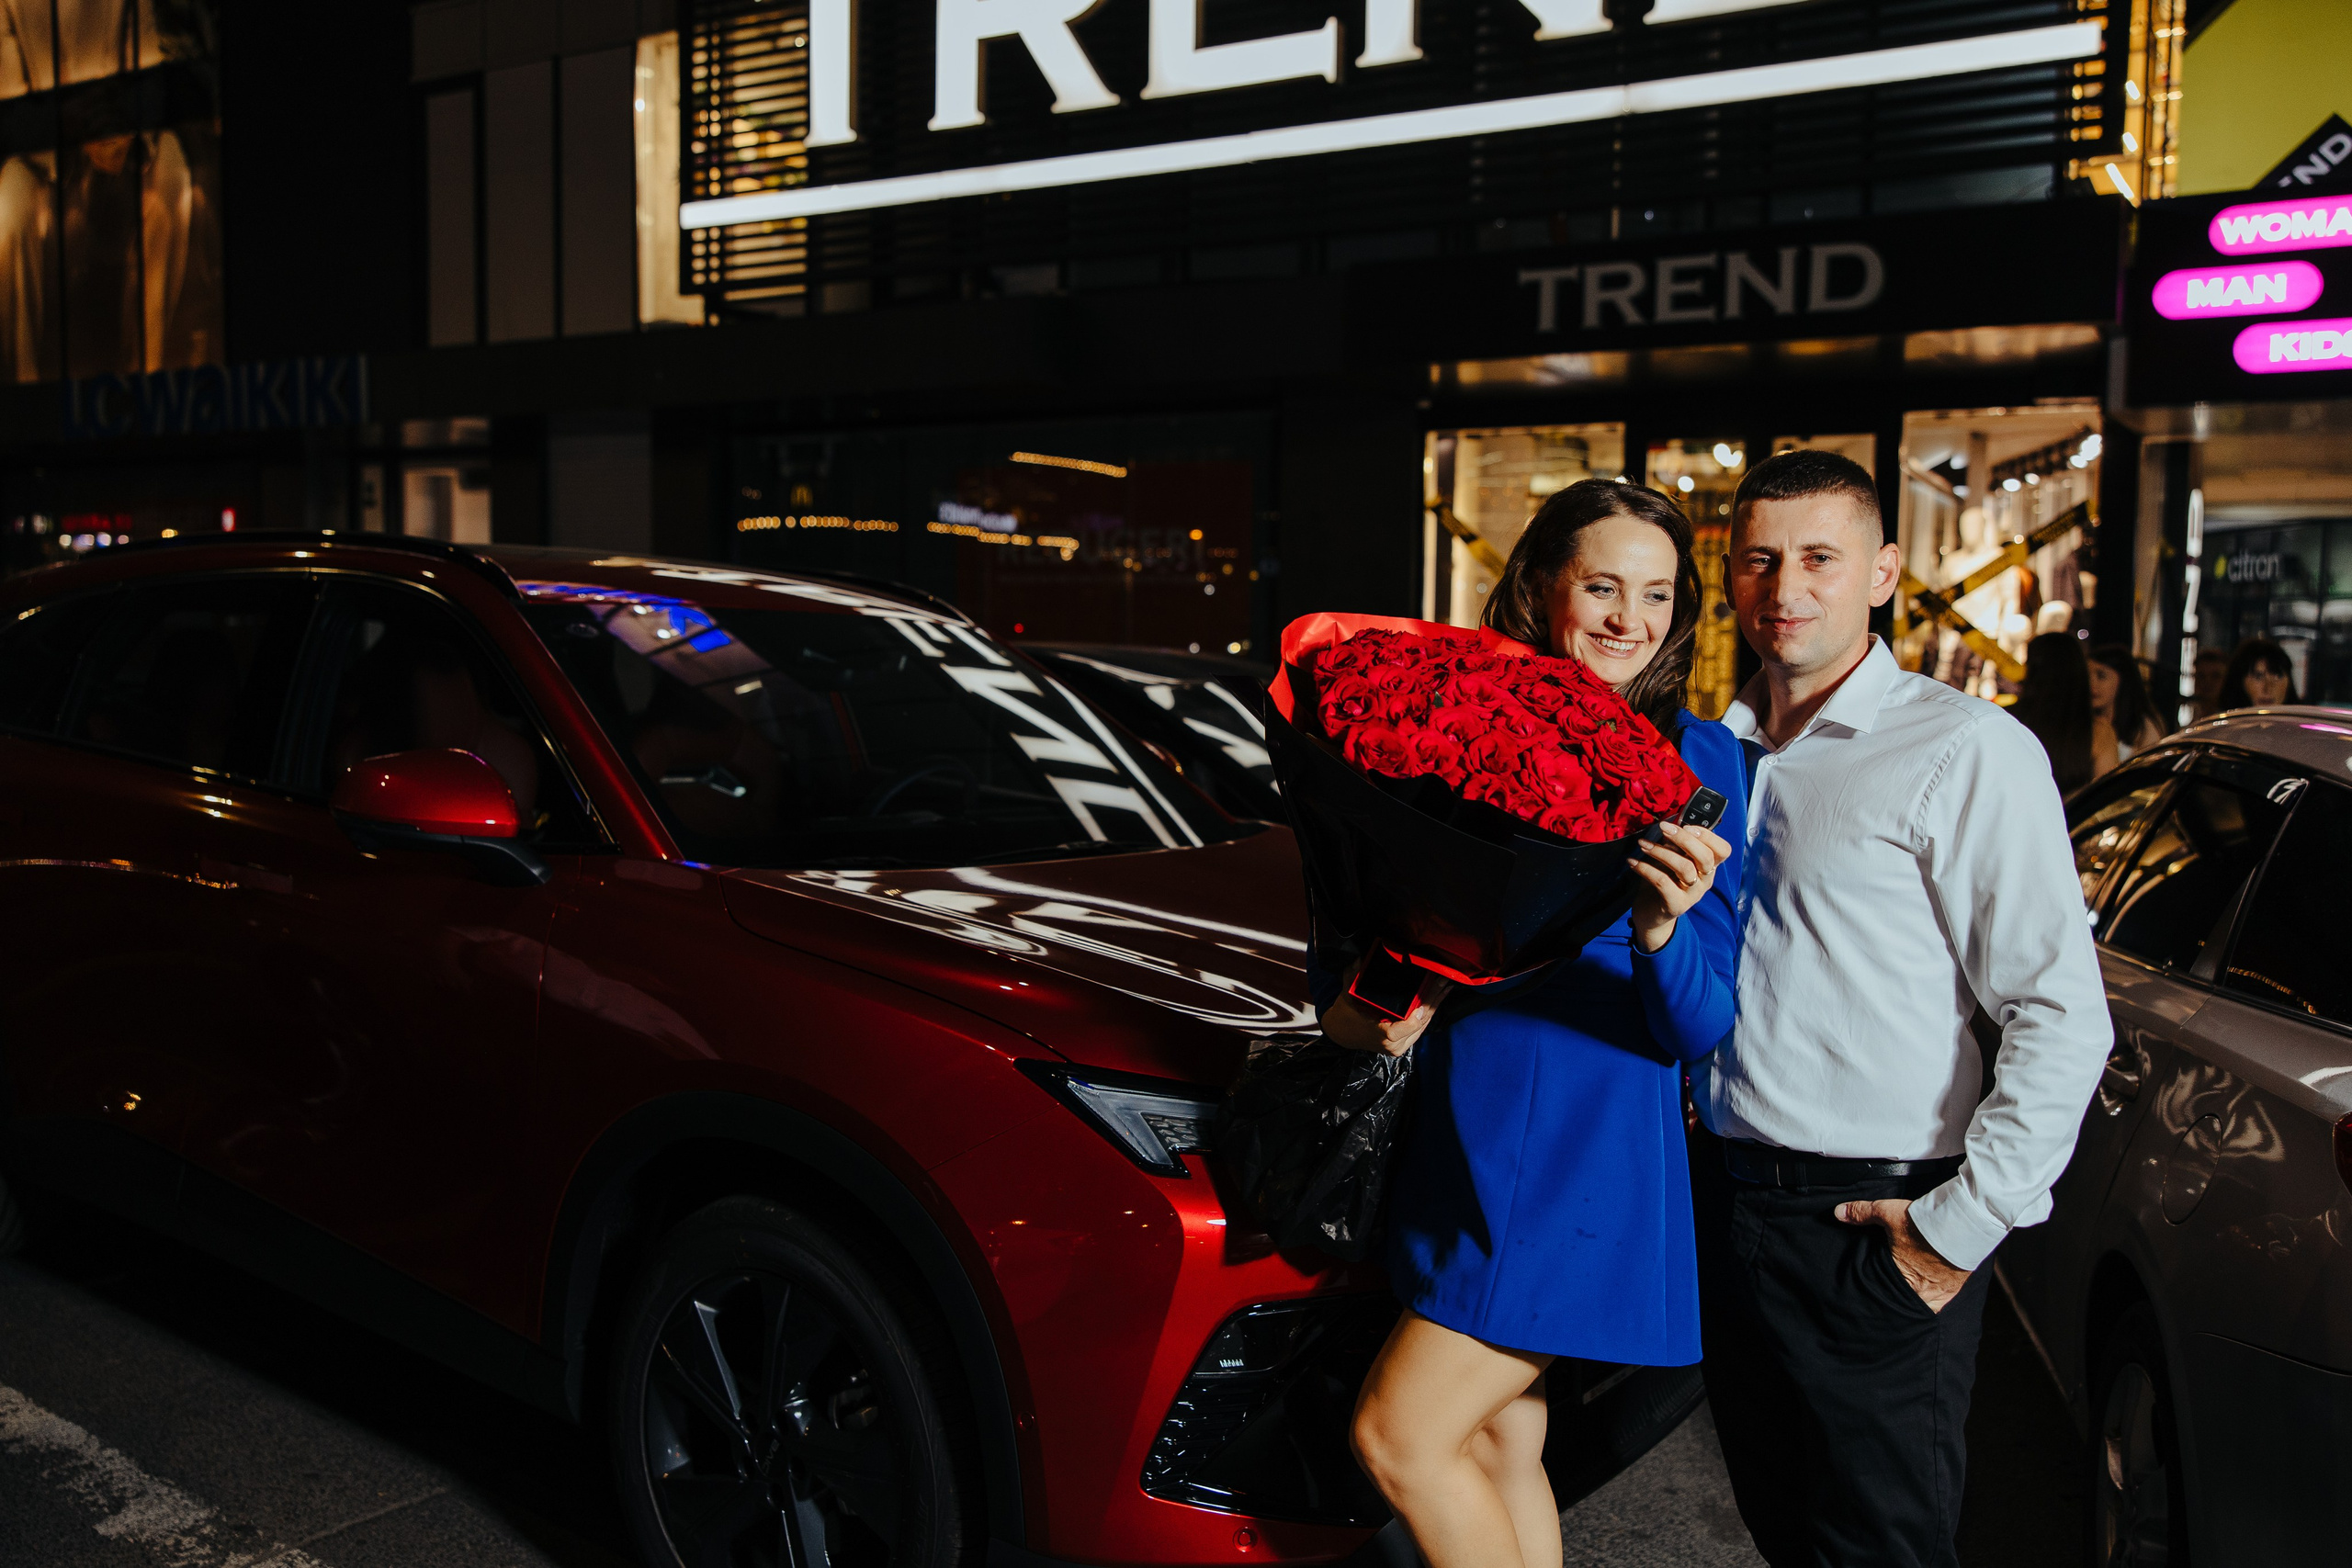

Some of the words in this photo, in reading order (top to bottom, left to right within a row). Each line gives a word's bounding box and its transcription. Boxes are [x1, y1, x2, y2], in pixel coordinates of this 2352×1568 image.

[2278, 133, 2352, 187] ND
[1517, 243, 1884, 332] TREND
[2187, 273, 2287, 309] MAN
[2227, 548, 2281, 584] citron
